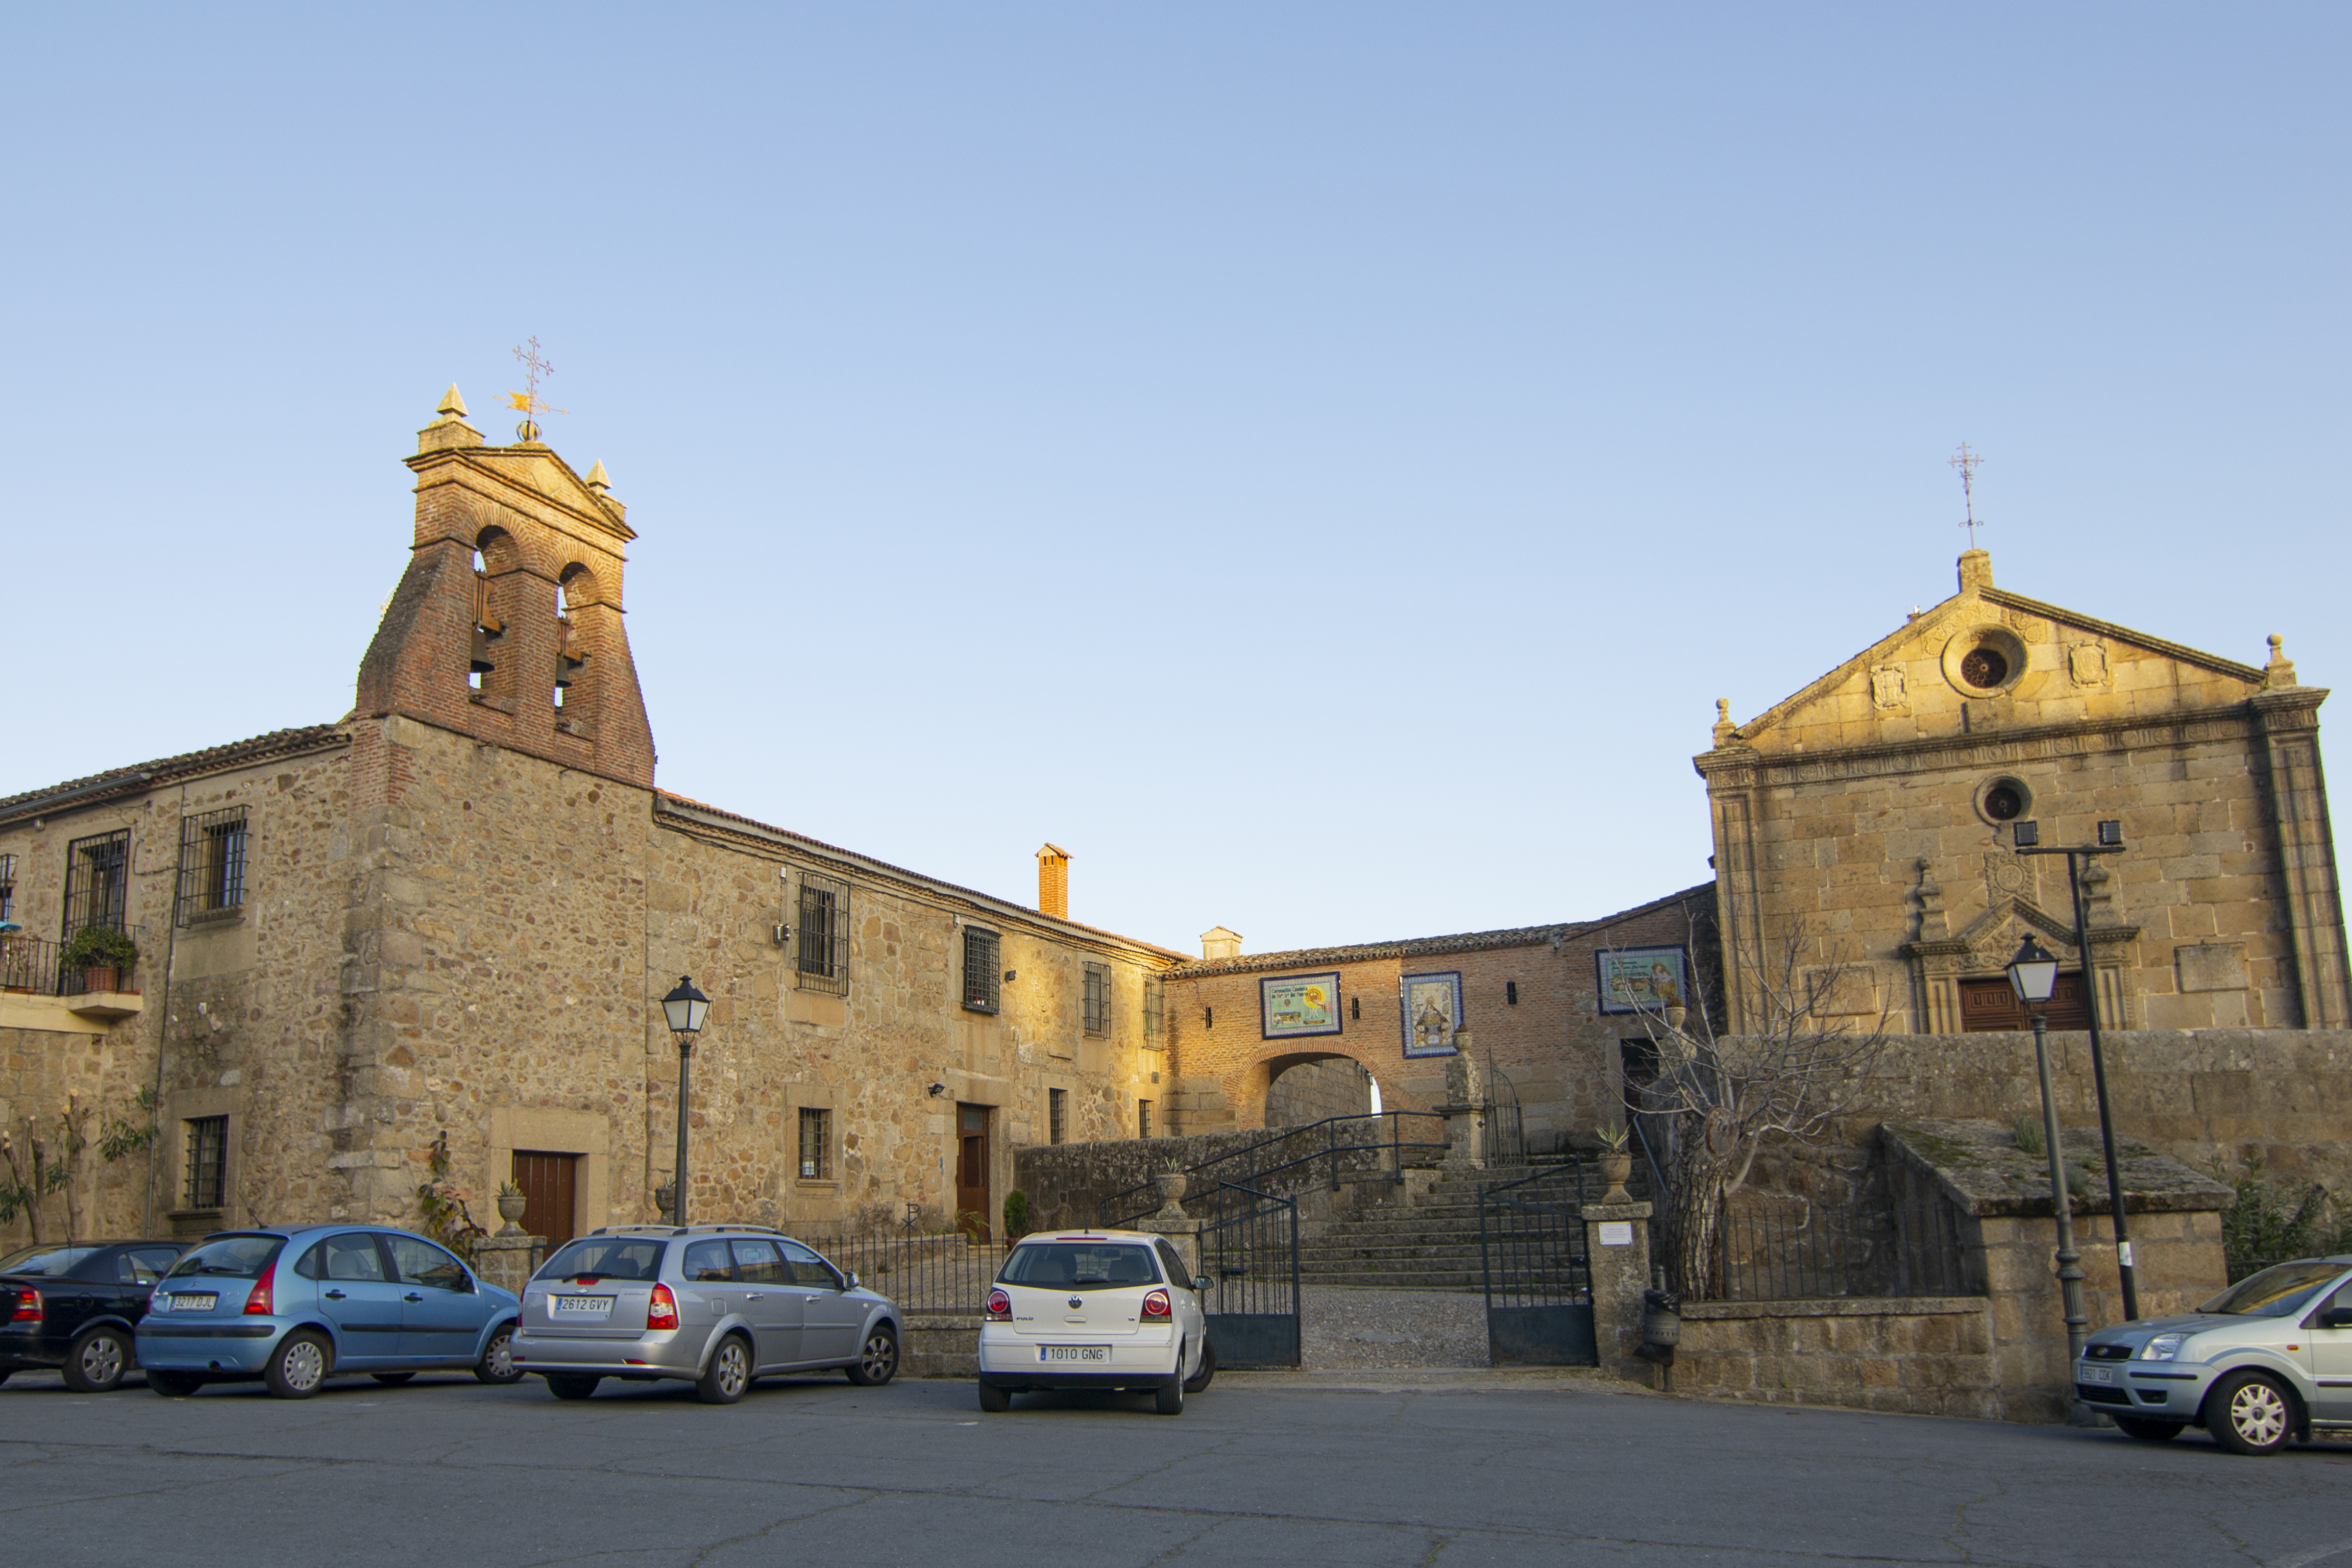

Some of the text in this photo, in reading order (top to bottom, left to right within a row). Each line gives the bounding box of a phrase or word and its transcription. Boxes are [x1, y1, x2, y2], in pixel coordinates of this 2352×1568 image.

[176, 1297, 212, 1307] 3217 DJL
[562, 1299, 609, 1310] 2612 GVY
[1051, 1349, 1103, 1359] 1010 GNG
